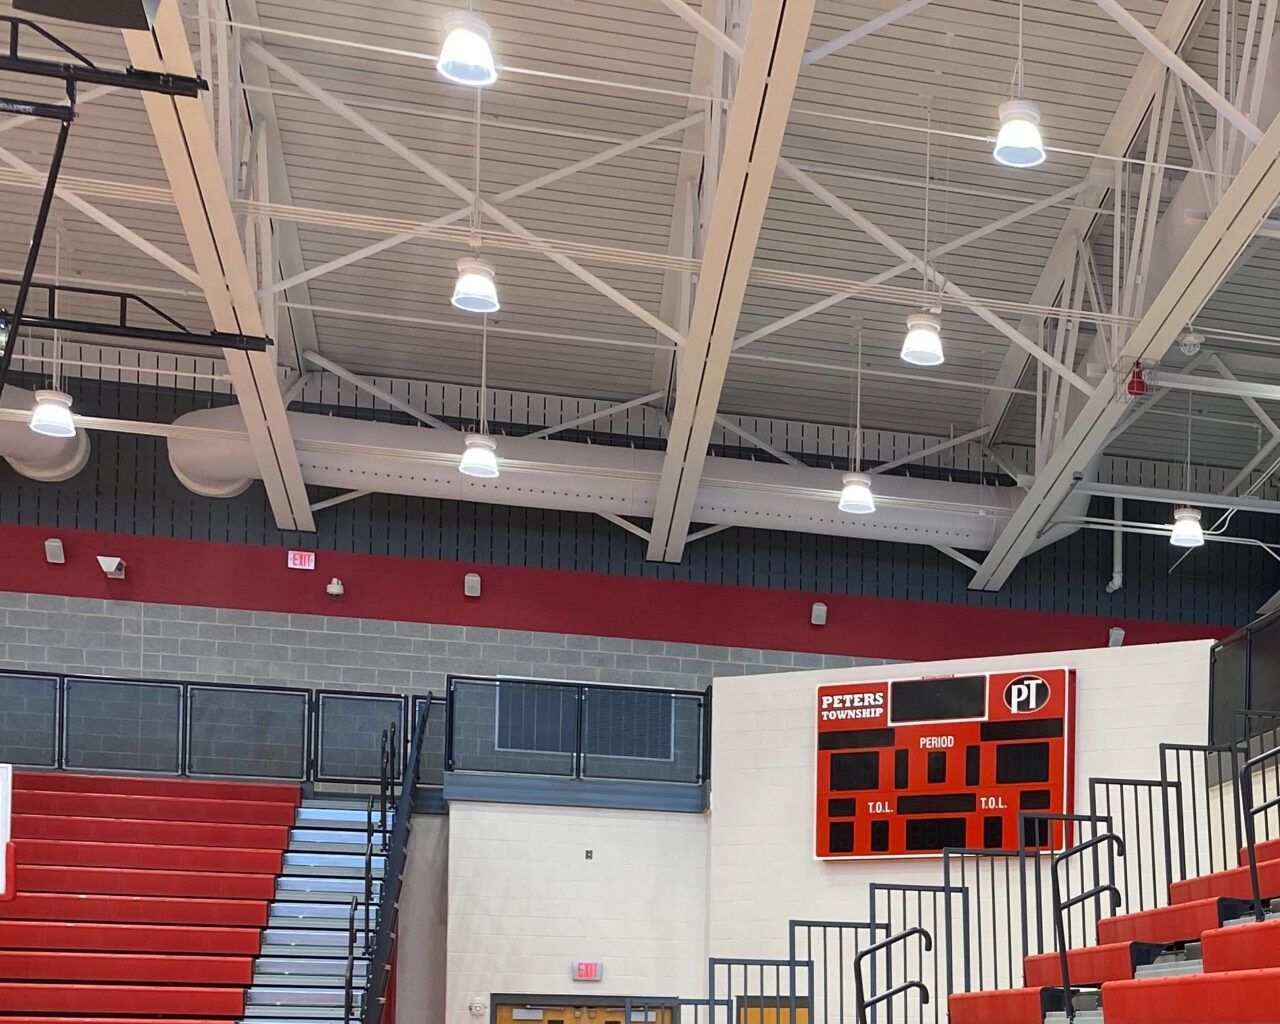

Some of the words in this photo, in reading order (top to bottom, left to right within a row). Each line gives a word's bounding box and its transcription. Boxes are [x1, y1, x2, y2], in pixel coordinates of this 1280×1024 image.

[293, 553, 312, 567] EXIT
[822, 693, 884, 708] PETERS
[1011, 680, 1042, 714] PT
[821, 708, 884, 720] TOWNSHIP
[920, 736, 954, 748] PERIOD
[868, 802, 894, 813] T.O.L.
[981, 797, 1007, 809] T.O.L.
[578, 962, 598, 977] EXIT
